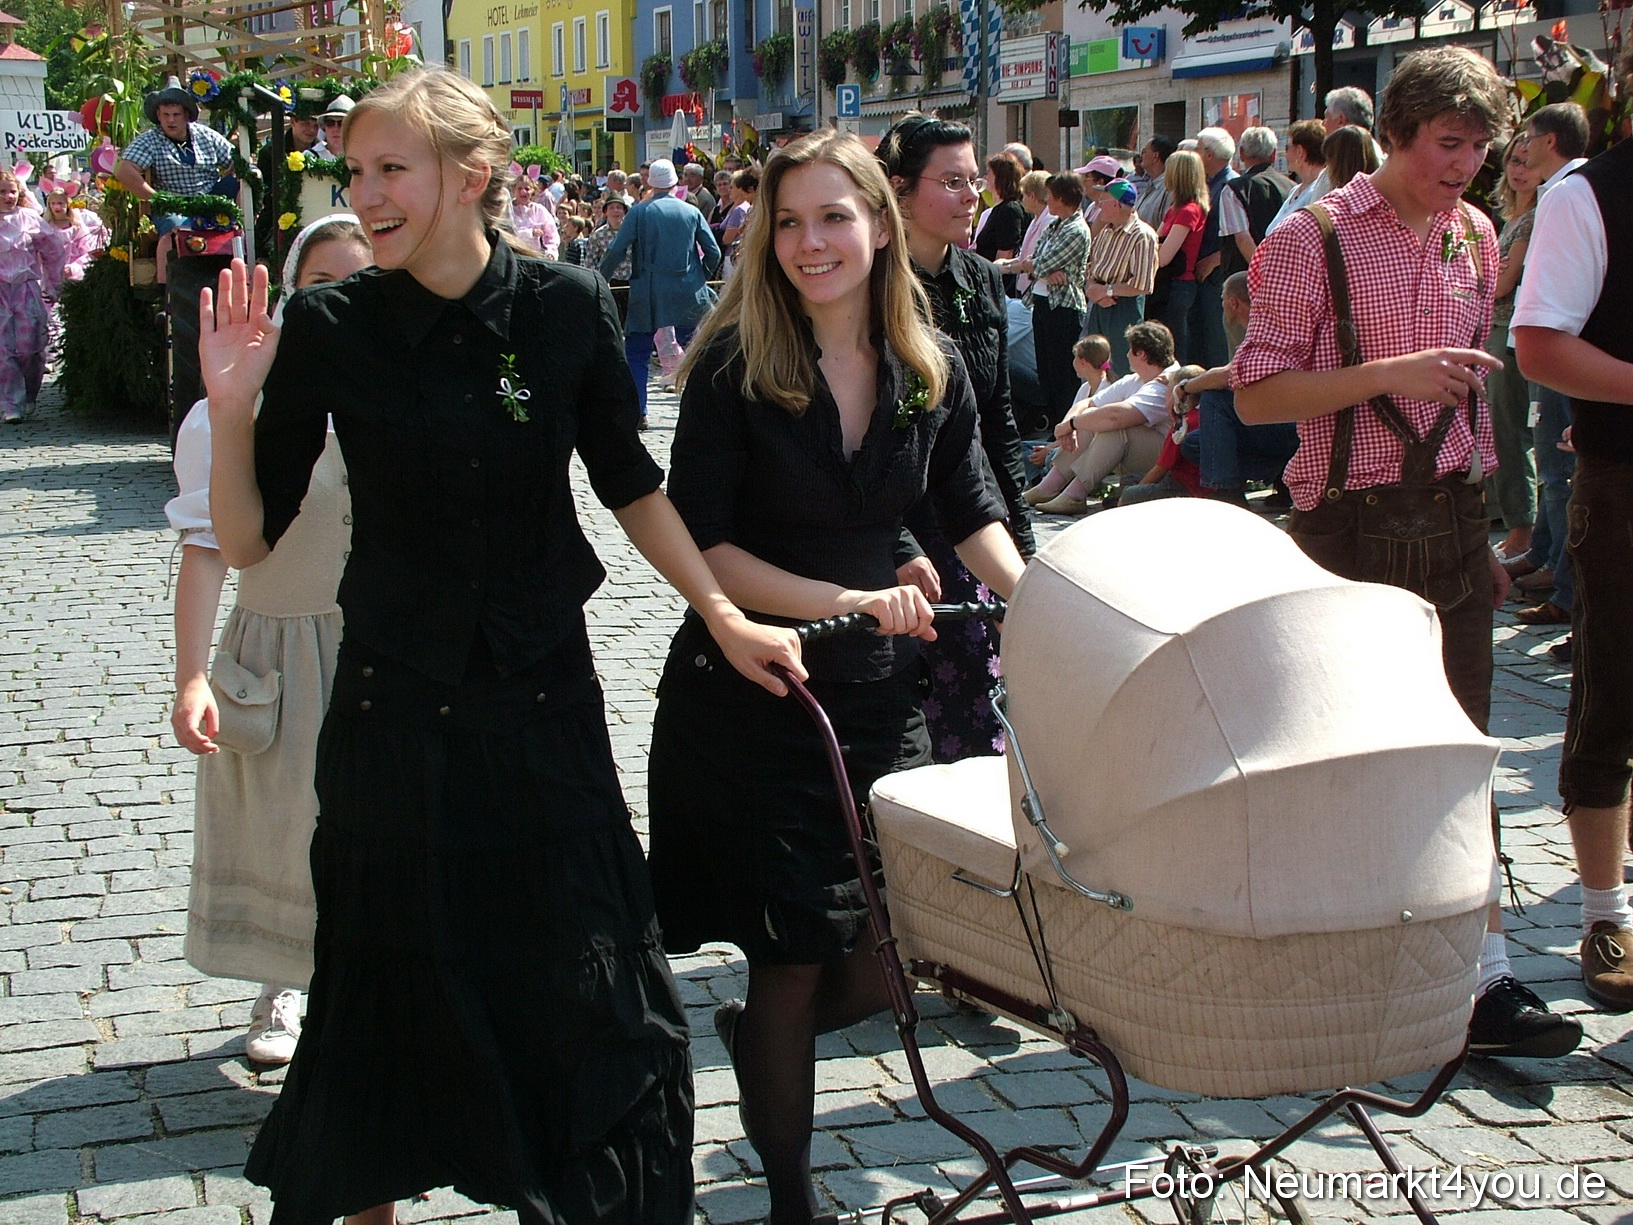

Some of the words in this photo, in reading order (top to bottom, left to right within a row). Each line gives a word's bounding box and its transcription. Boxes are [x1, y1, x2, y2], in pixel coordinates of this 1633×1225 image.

[487, 6, 509, 27] HOTEL
[798, 25, 811, 90] WITTL
[1002, 64, 1010, 77] DIE
[1014, 60, 1042, 75] SIMPSONS
[1049, 36, 1057, 94] KINO
[842, 89, 855, 114] P
[5, 132, 87, 149] Röckersbühl
